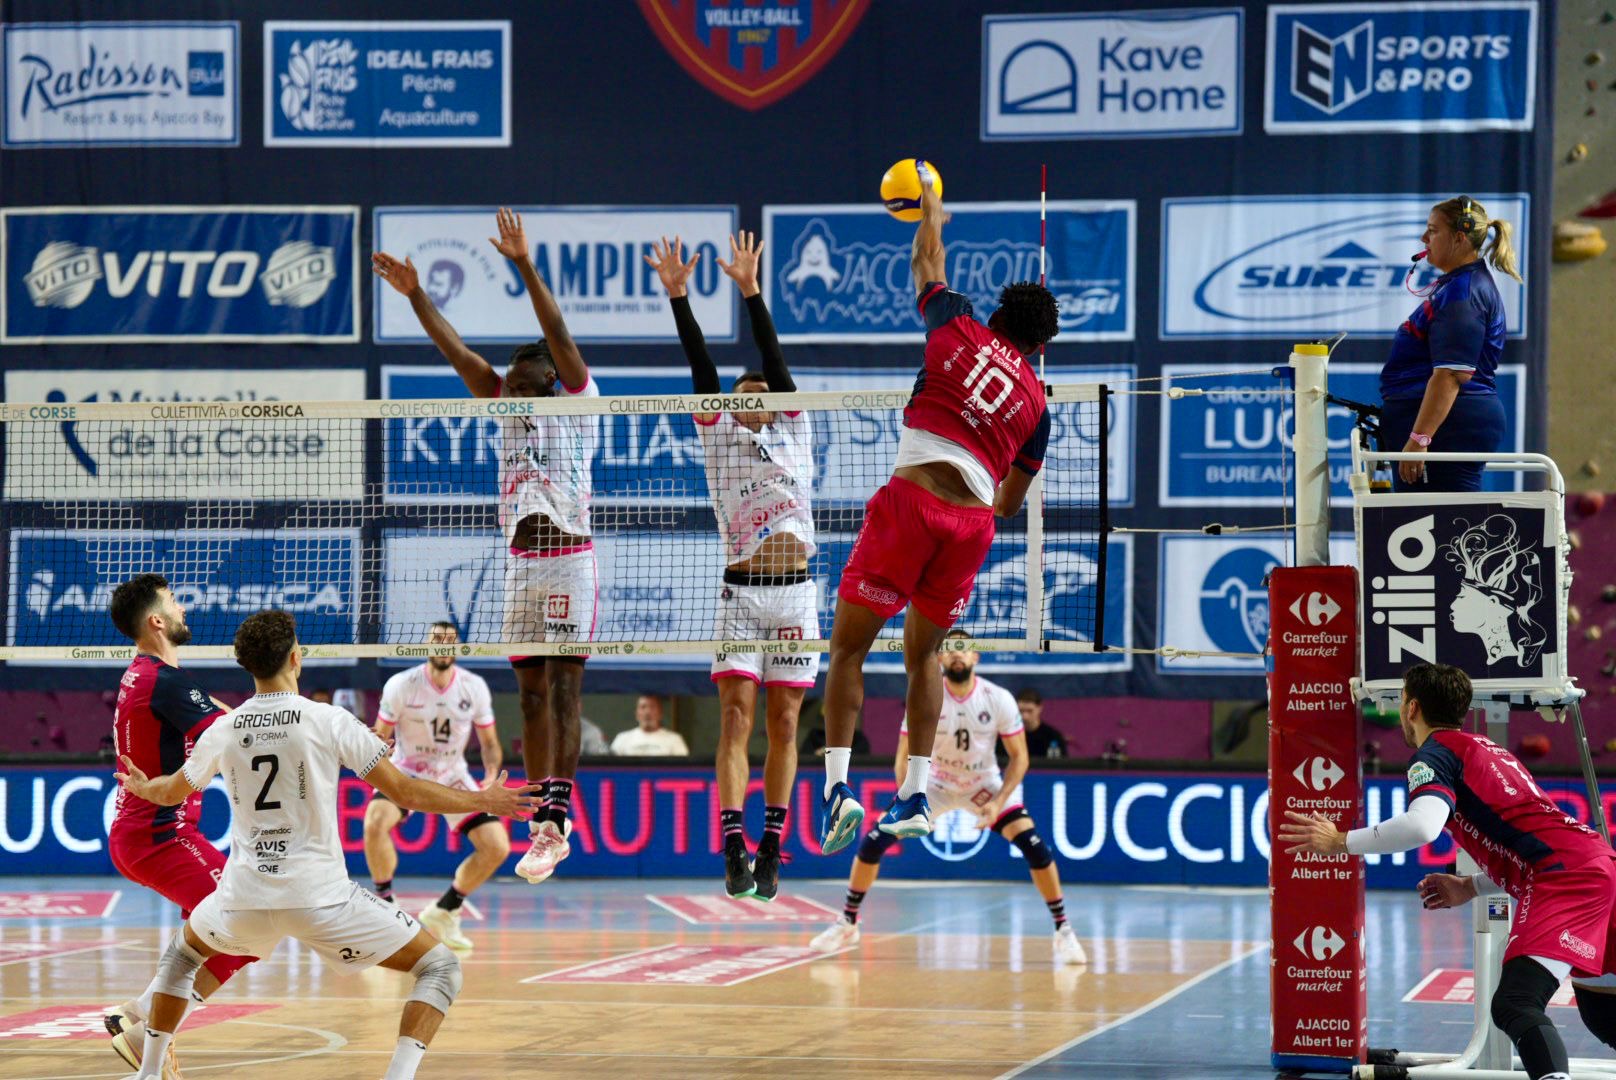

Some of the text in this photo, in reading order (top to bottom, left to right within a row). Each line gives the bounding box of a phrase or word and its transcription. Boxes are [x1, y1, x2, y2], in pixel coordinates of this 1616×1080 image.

[705, 8, 803, 26] VOLLEY-BALL
[1099, 37, 1203, 72] Kave
[1375, 35, 1511, 61] SPORTS
[367, 50, 428, 69] IDEAL
[432, 50, 493, 68] FRAIS
[20, 44, 183, 121] Radisson
[423, 95, 436, 109] &
[1098, 78, 1226, 113] Home
[379, 108, 479, 127] Aquaculture
[991, 338, 1022, 369] BALA
[962, 352, 1014, 414] 10
[151, 403, 304, 418] CULLETTIVITÀ DI CORSICA
[380, 400, 534, 416] COLLECTIVITÉ DE CORSE
[609, 396, 764, 412] CULLETTIVITÀ DI CORSICA
[30, 407, 76, 419] CORSE
[108, 428, 324, 457] de la Corse
[1371, 513, 1436, 665] zilia
[173, 584, 344, 612] ORSICA
[1282, 631, 1348, 644] Carrefour
[110, 649, 132, 659] vert
[434, 645, 456, 655] vert
[596, 644, 619, 655] vert
[761, 643, 784, 652] vert
[1292, 646, 1339, 657] market
[771, 656, 812, 666] AMAT
[1289, 683, 1343, 694] AJACCIO
[1286, 699, 1347, 711] Albert 1er
[233, 710, 301, 729] GROSNON
[430, 717, 451, 738] 14
[256, 730, 288, 741] FORMA
[251, 754, 282, 811] 2
[1286, 797, 1352, 809] Carrefour
[260, 827, 292, 836] zeendoc
[1453, 811, 1479, 839] CLUB
[255, 840, 287, 852] AVIS
[1291, 868, 1352, 879] Albert 1er
[1287, 966, 1352, 979] Carrefour
[1296, 981, 1342, 993] market
[1296, 1019, 1350, 1030] AJACCIO
[1293, 1036, 1354, 1048] Albert 1er
